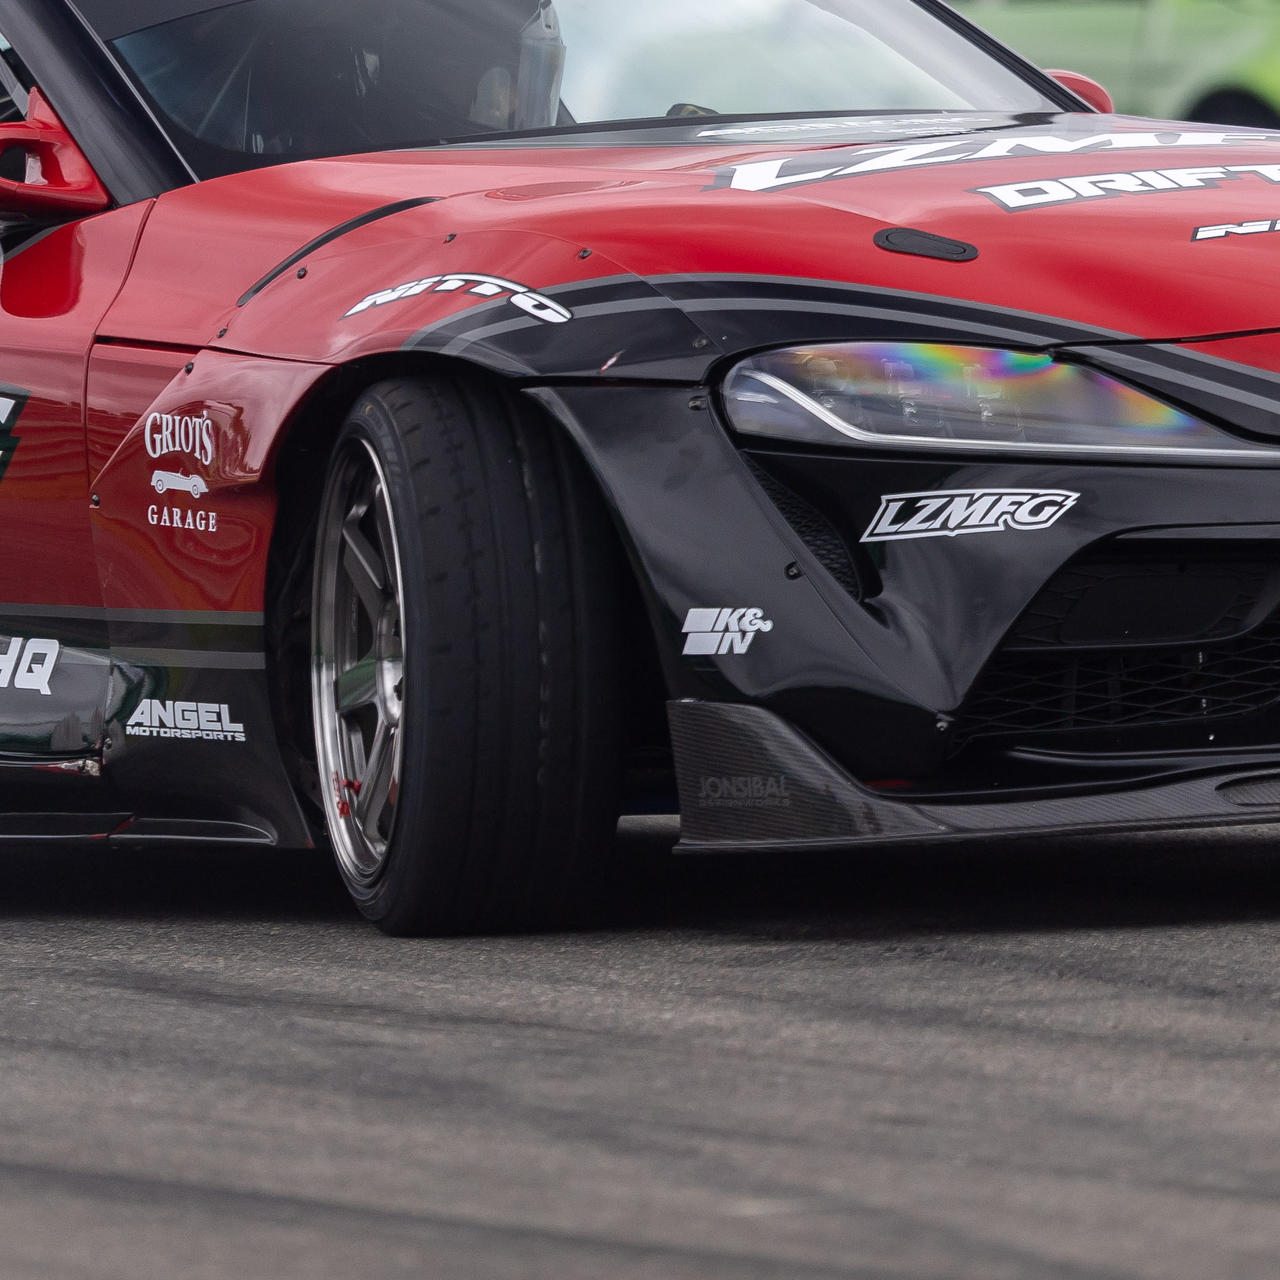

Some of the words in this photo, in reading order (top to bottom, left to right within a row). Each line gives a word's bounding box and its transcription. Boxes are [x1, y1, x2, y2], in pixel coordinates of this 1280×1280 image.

[342, 272, 573, 323] NITTO
[144, 410, 213, 466] GRIOT'S
[147, 503, 218, 532] GARAGE
[872, 494, 1066, 535] LZMFG
[126, 698, 245, 732] ANGEL
[125, 725, 247, 743] MOTORSPORTS
